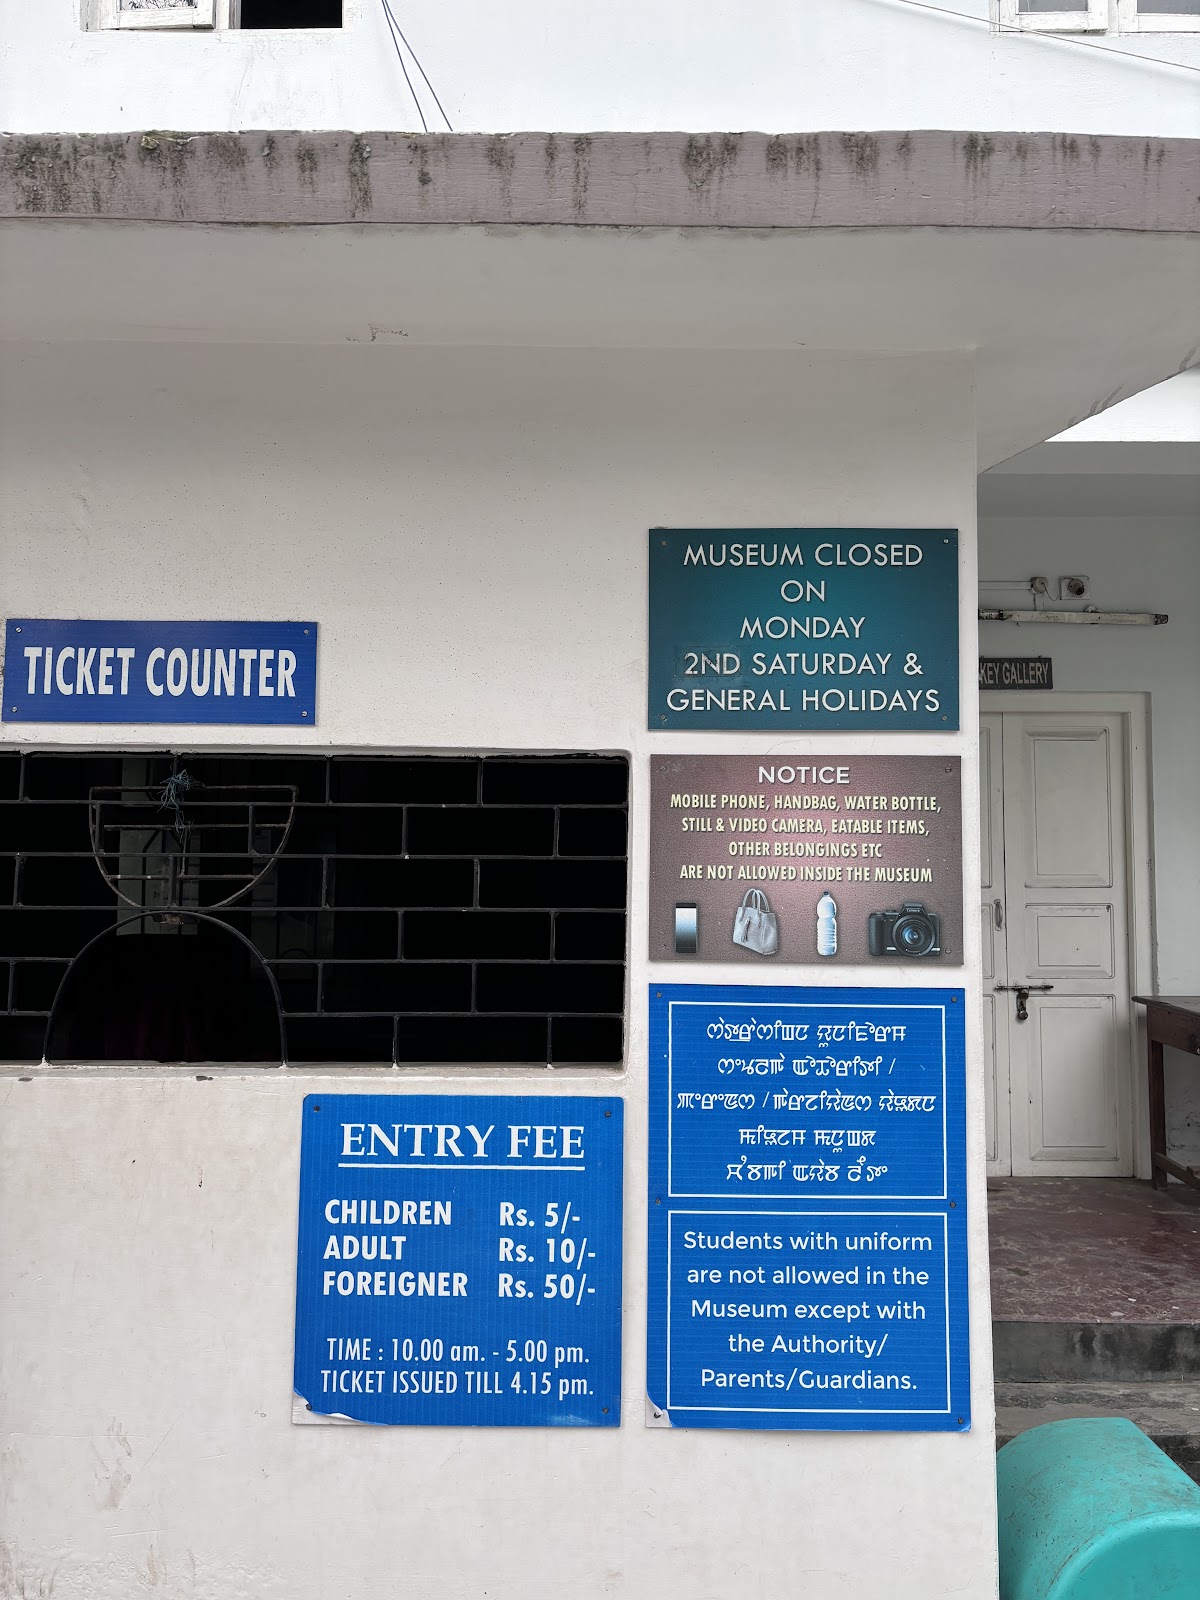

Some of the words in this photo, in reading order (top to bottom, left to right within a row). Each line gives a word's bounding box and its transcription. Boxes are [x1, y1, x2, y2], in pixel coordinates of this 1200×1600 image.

[684, 544, 803, 566] MUSEUM
[815, 544, 922, 566] CLOSED
[781, 580, 824, 602] ON
[740, 617, 865, 638] MONDAY
[24, 647, 135, 695] TICKET
[146, 648, 296, 697] COUNTER
[685, 653, 740, 674] 2ND
[752, 653, 891, 675] SATURDAY
[904, 653, 923, 675] &
[1003, 663, 1048, 684] GALLERY
[667, 689, 790, 711] GENERAL
[803, 689, 939, 711] HOLIDAYS
[759, 766, 849, 783] NOTICE
[671, 794, 716, 808] MOBILE
[722, 795, 770, 811] PHONE,
[775, 795, 840, 811] HANDBAG,
[844, 796, 887, 809] WATER
[892, 796, 941, 813] BOTTLE,
[682, 818, 712, 831] STILL
[716, 818, 724, 831] &
[729, 818, 767, 832] VIDEO
[772, 818, 826, 835] CAMERA,
[832, 819, 882, 833] EATABLE
[888, 820, 929, 836] ITEMS,
[729, 841, 770, 855] OTHER
[774, 842, 857, 857] BELONGINGS
[862, 843, 881, 857] ETC
[680, 865, 702, 878] ARE
[708, 865, 733, 879] NOT
[738, 866, 796, 879] ALLOWED
[799, 865, 841, 881] INSIDE
[846, 867, 869, 880] THE
[875, 867, 932, 882] MUSEUM
[341, 1124, 494, 1157] ENTRY
[507, 1126, 584, 1158] FEE
[325, 1199, 451, 1225] CHILDREN
[500, 1202, 534, 1226] Rs.
[545, 1202, 580, 1234] 5/-
[684, 1231, 782, 1249] Students
[790, 1232, 837, 1250] with
[846, 1232, 931, 1250] uniform
[323, 1235, 406, 1260] ADULT
[499, 1238, 534, 1262] Rs.
[547, 1238, 595, 1269] 10/-
[688, 1270, 721, 1283] are
[730, 1267, 765, 1283] not
[773, 1266, 858, 1284] allowed
[867, 1266, 885, 1284] in
[893, 1267, 929, 1285] the
[324, 1271, 467, 1296] FOREIGNER
[499, 1274, 533, 1298] Rs.
[544, 1274, 595, 1305] 50/-
[692, 1300, 787, 1318] Museum
[795, 1302, 870, 1322] except
[877, 1301, 925, 1319] with
[327, 1338, 371, 1360] TIME
[379, 1349, 383, 1360] :
[393, 1339, 443, 1361] 10.00
[451, 1346, 485, 1361] am.
[506, 1340, 547, 1362] 5.00
[555, 1347, 589, 1368] pm.
[729, 1334, 764, 1352] the
[771, 1334, 888, 1358] Authority/
[321, 1370, 385, 1393] TICKET
[393, 1371, 457, 1393] ISSUED
[465, 1372, 502, 1393] TILL
[511, 1372, 551, 1394] 4.15
[559, 1379, 593, 1400] pm.
[702, 1368, 916, 1390] Parents/Guardians.
